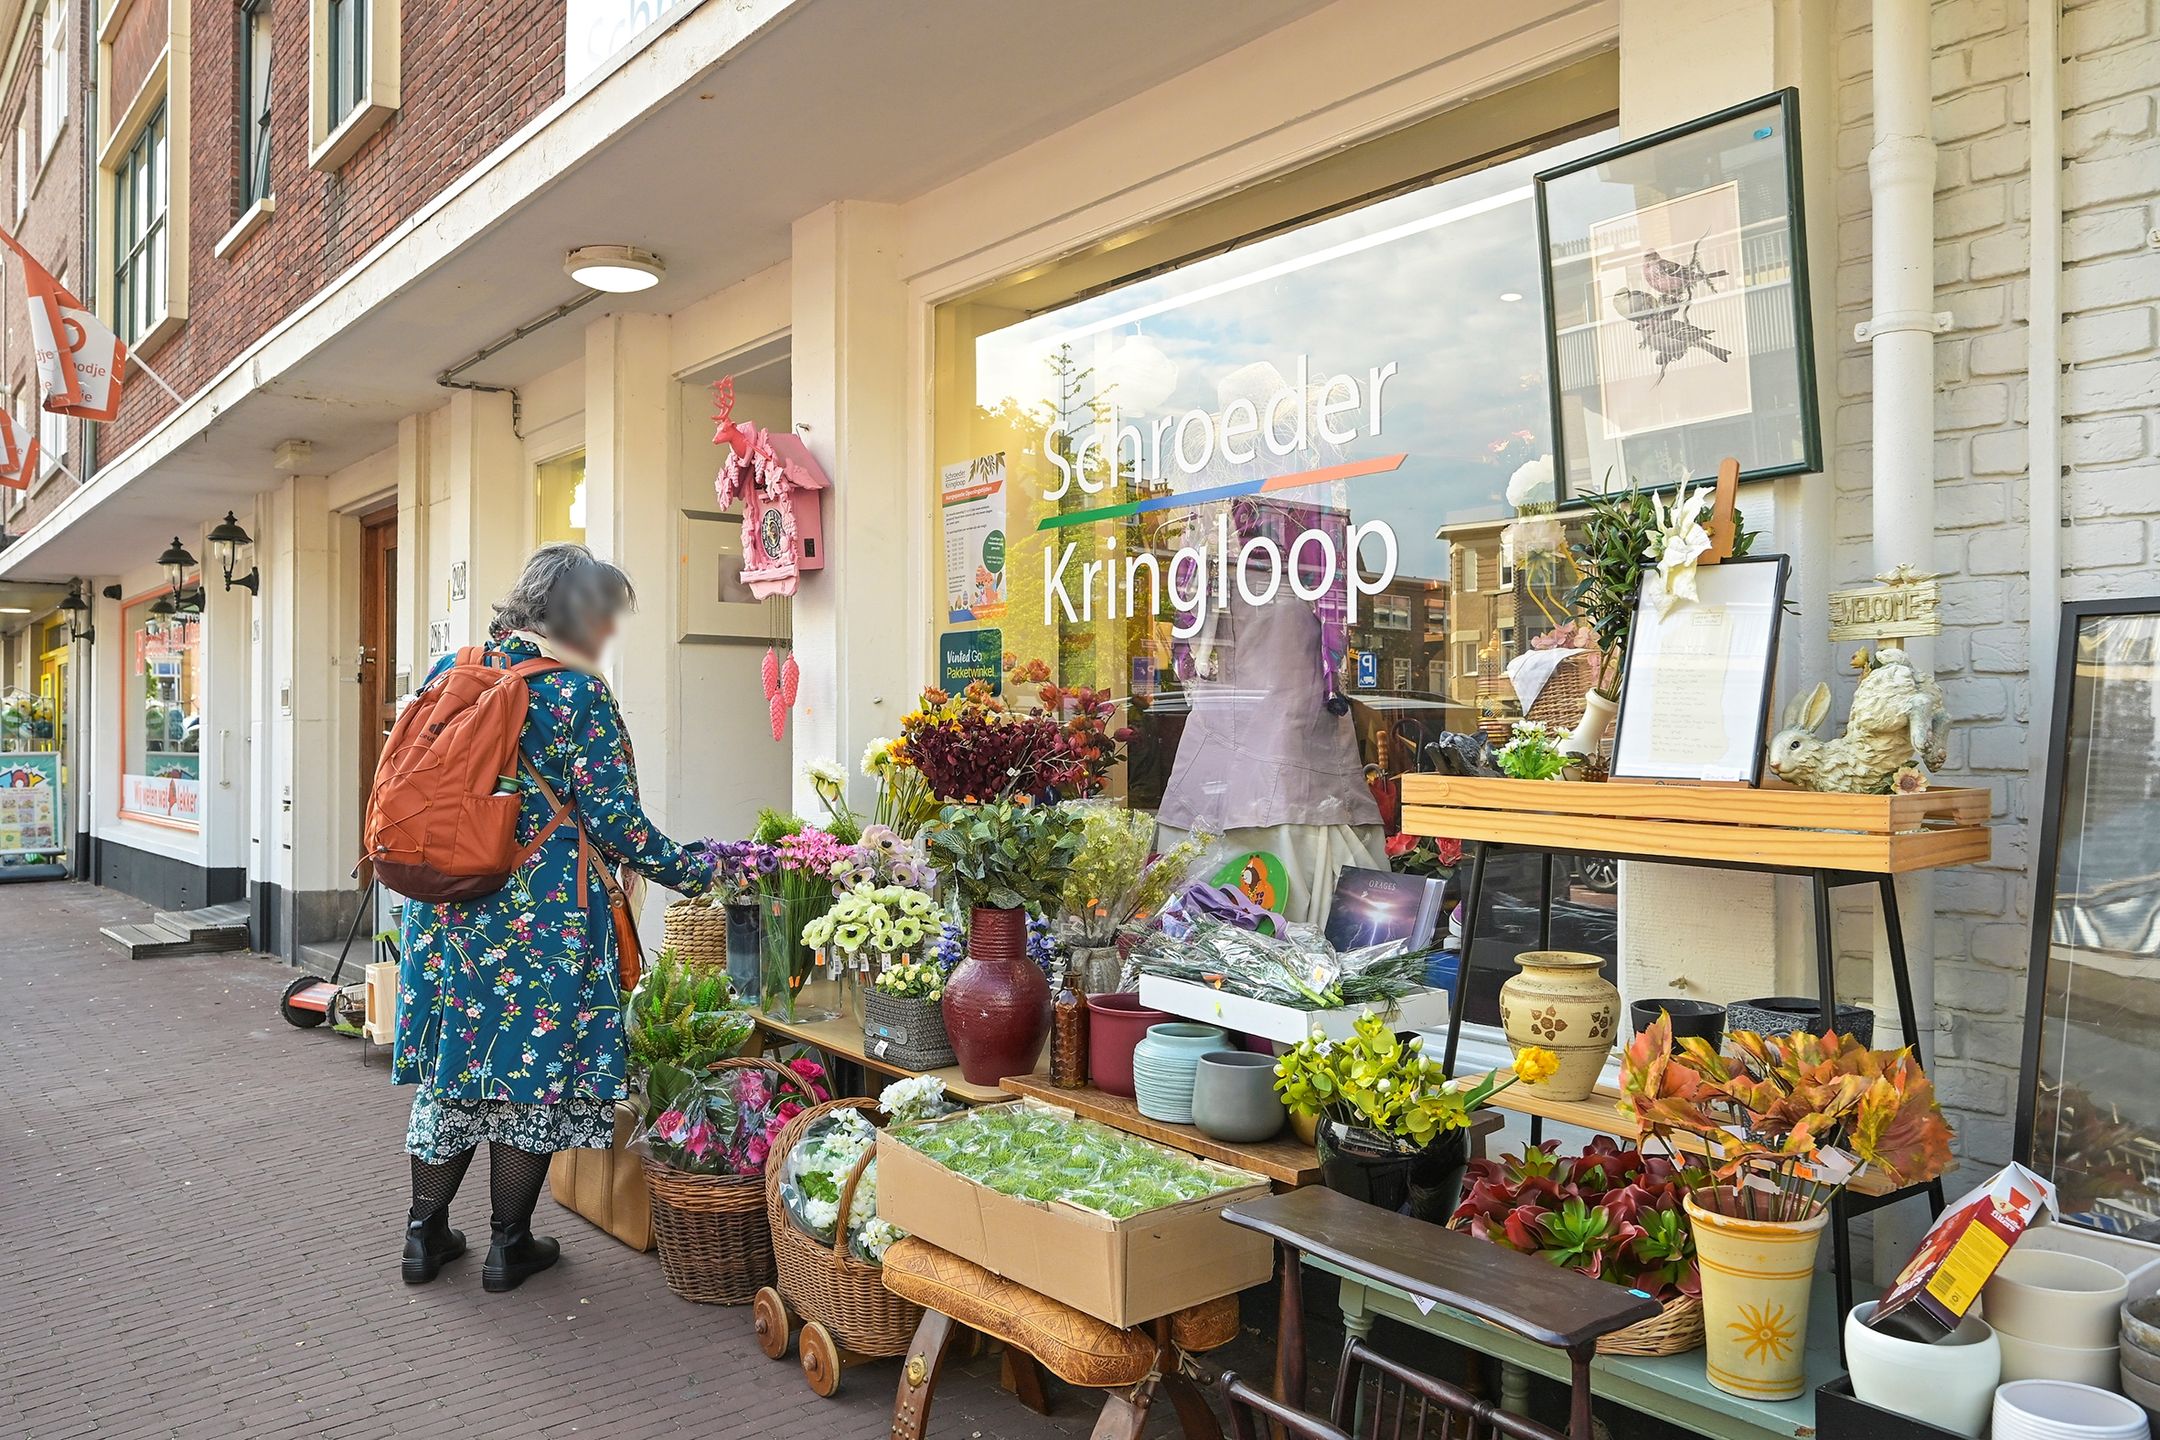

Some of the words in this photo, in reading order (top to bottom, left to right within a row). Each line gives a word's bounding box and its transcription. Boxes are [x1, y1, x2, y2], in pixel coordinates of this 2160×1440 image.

[1043, 354, 1398, 502] Schroeder
[1043, 513, 1398, 639] Kringloop
[1840, 592, 1920, 624] WELCOME
[947, 649, 970, 664] Vinted
[971, 650, 982, 662] Go
[947, 665, 995, 679] Pakketwinkel
[1369, 880, 1397, 891] ORAGES
